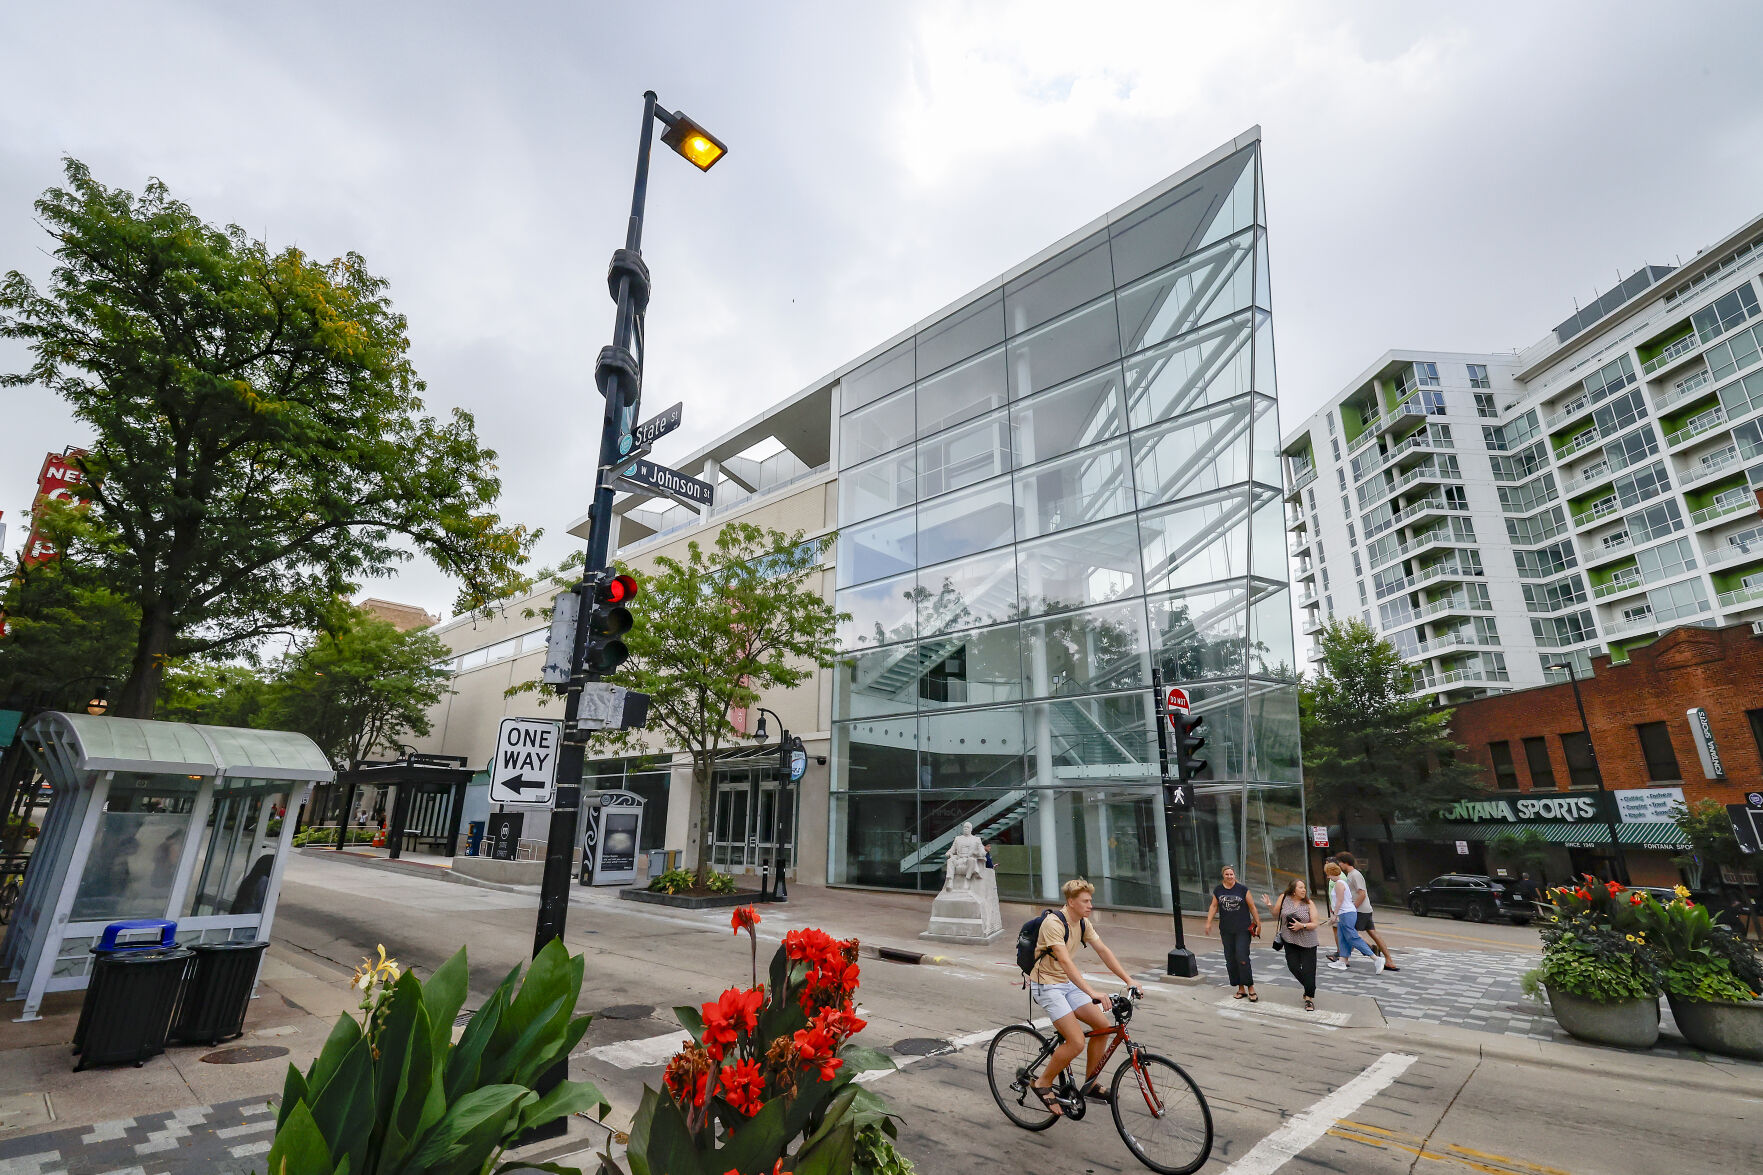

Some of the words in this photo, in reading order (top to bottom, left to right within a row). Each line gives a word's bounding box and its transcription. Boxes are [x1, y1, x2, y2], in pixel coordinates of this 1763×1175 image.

[635, 416, 667, 446] State
[671, 410, 678, 423] St
[46, 466, 87, 484] NE
[641, 465, 648, 476] W
[649, 466, 701, 499] Johnson
[703, 488, 711, 499] St
[507, 727, 551, 749] ONE
[1698, 711, 1712, 739] SPORTS
[504, 750, 550, 771] WAY
[1707, 740, 1723, 776] FONTANA
[1517, 797, 1594, 822] SPORTS
